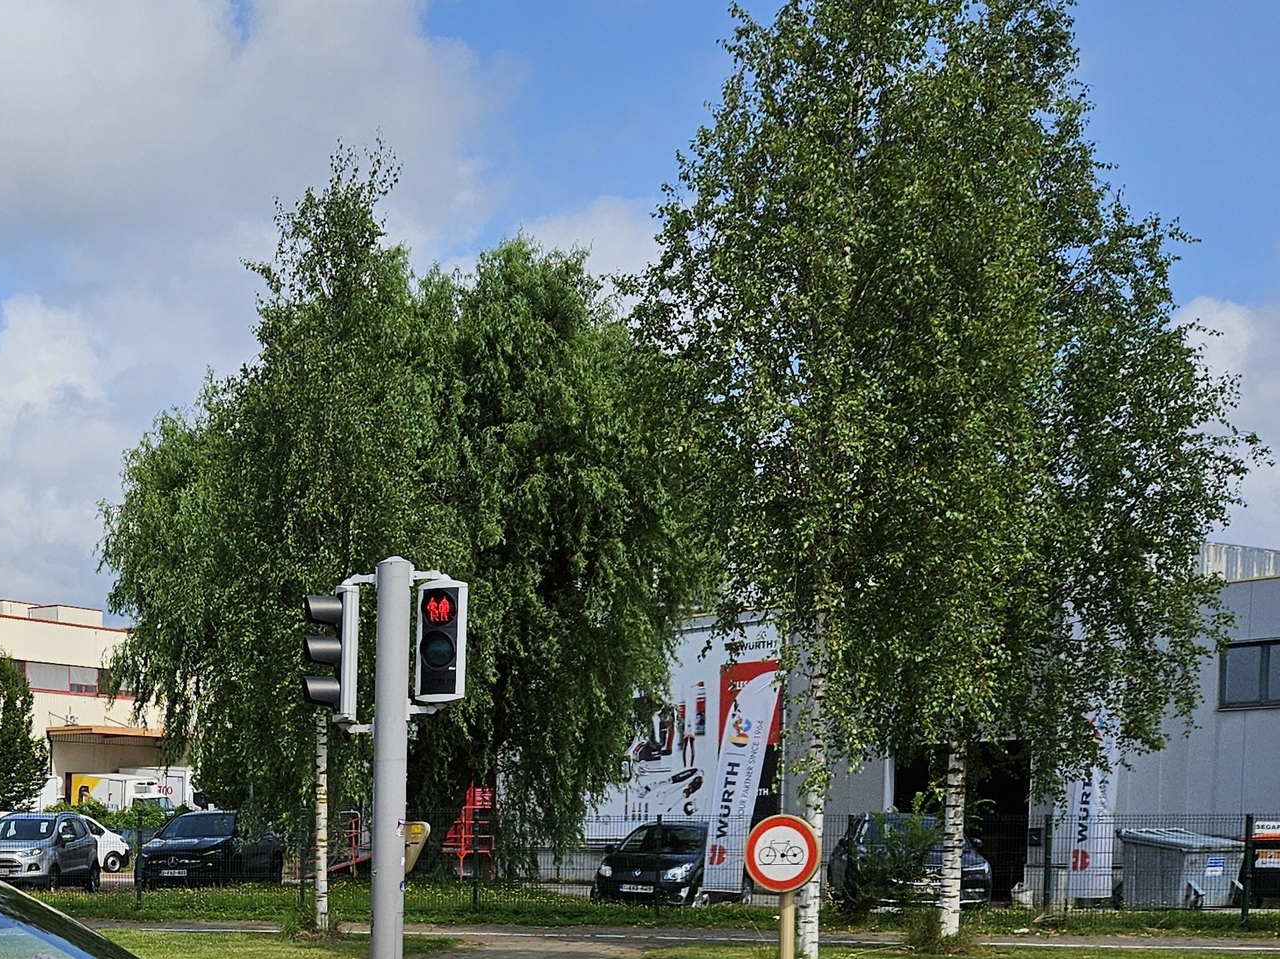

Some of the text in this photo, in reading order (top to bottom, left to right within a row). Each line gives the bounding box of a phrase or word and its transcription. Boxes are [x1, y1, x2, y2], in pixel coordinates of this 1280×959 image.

[754, 720, 765, 739] 1964
[749, 740, 761, 767] SINCE
[743, 767, 755, 800] PARTNER
[716, 762, 741, 839] WÜRTH
